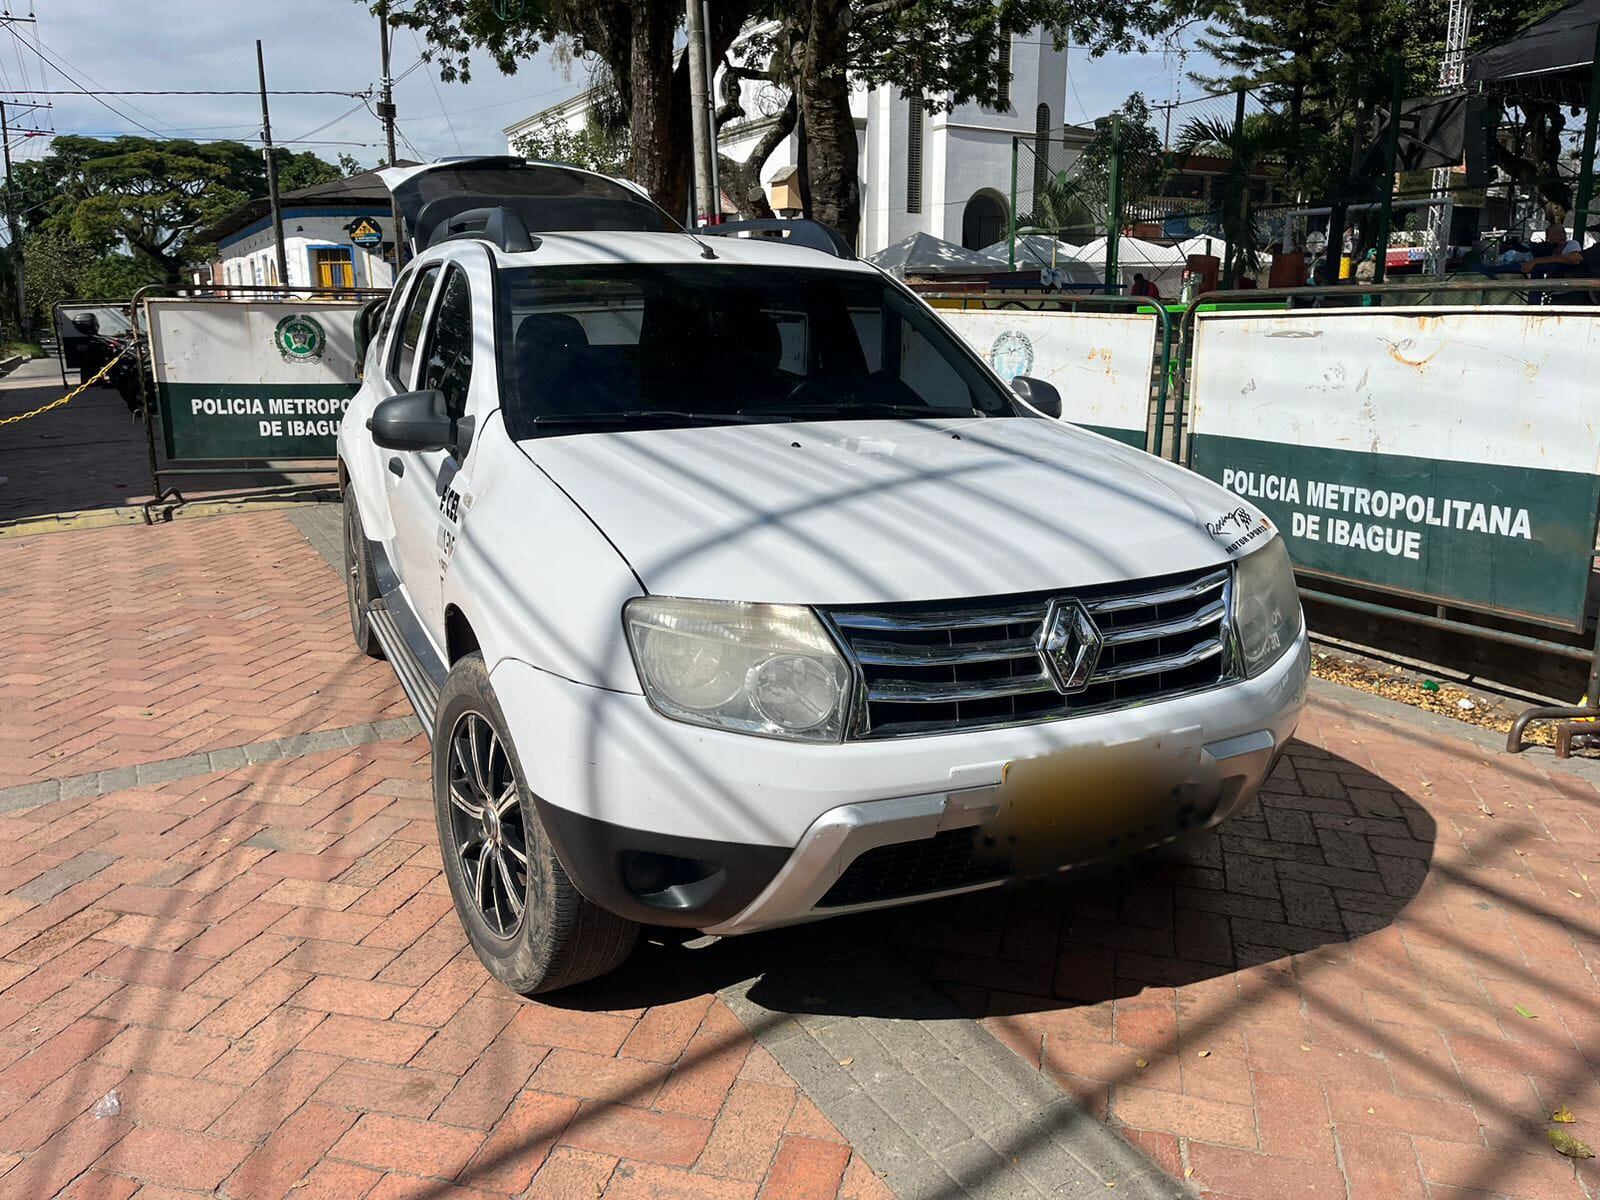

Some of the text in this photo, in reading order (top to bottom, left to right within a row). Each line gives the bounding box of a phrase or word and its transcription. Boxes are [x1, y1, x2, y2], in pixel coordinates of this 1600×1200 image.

[191, 398, 265, 415] POLICIA
[259, 420, 284, 437] DE
[1222, 468, 1532, 539] POLICIA METROPOLITANA
[1225, 536, 1250, 555] MOTOR
[1291, 512, 1421, 560] DE IBAGUE
